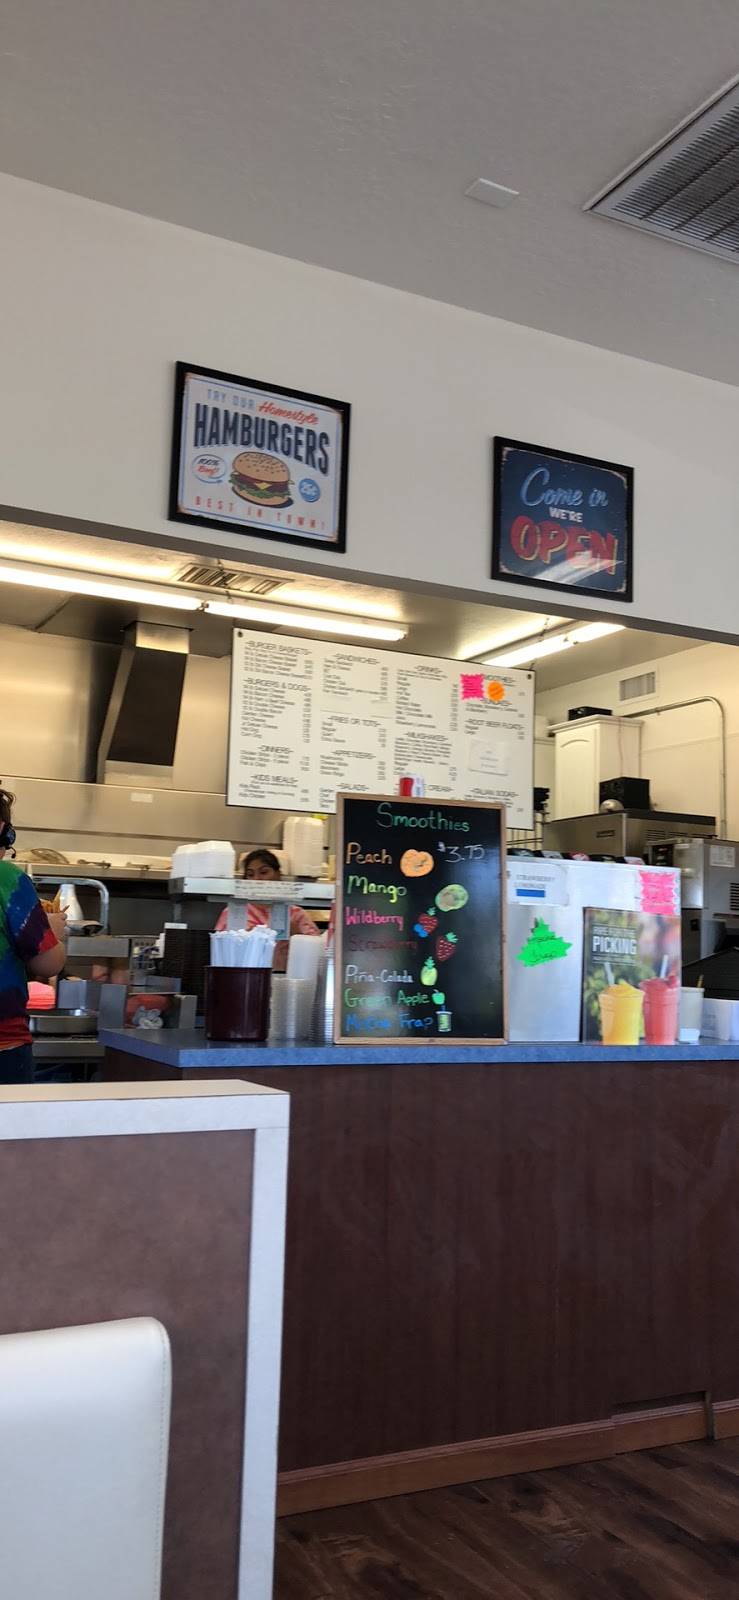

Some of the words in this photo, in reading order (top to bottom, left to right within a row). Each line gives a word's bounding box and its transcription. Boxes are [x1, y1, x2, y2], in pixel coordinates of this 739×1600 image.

[208, 389, 227, 403] TRY
[233, 395, 256, 408] OUR
[258, 401, 320, 425] Homestyle
[194, 403, 330, 477] HAMBURGERS
[520, 466, 584, 507] Come
[588, 488, 609, 507] in
[195, 496, 235, 512] BEST
[248, 504, 263, 517] IN
[276, 511, 325, 530] TOWN!
[549, 507, 583, 523] WE'RE
[510, 515, 618, 576] OPEN
[376, 802, 470, 833] Smoothies
[345, 842, 393, 866] Peach
[437, 841, 486, 864] $3.75
[347, 875, 408, 904] Mango
[345, 907, 404, 932] Wildberry
[347, 936, 418, 954] Strawberry
[592, 936, 638, 955] PICKING
[344, 988, 391, 1008] Green
[397, 989, 431, 1009] Apple
[399, 1011, 435, 1029] Frap
